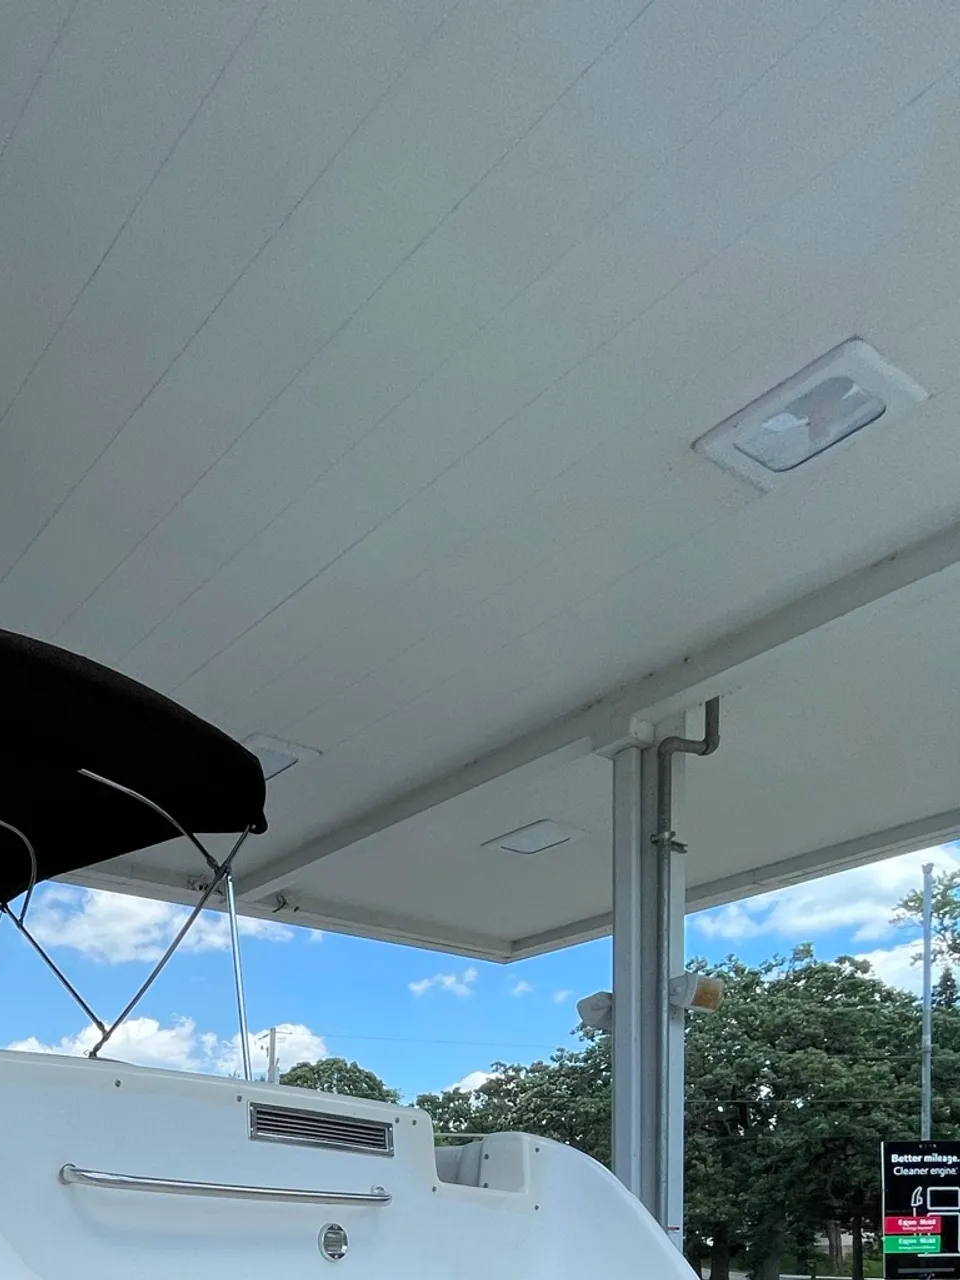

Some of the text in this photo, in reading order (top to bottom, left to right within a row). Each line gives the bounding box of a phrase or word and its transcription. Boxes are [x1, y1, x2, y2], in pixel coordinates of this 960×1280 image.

[891, 1153, 960, 1165] Better mileage.
[893, 1166, 929, 1176] Cleaner
